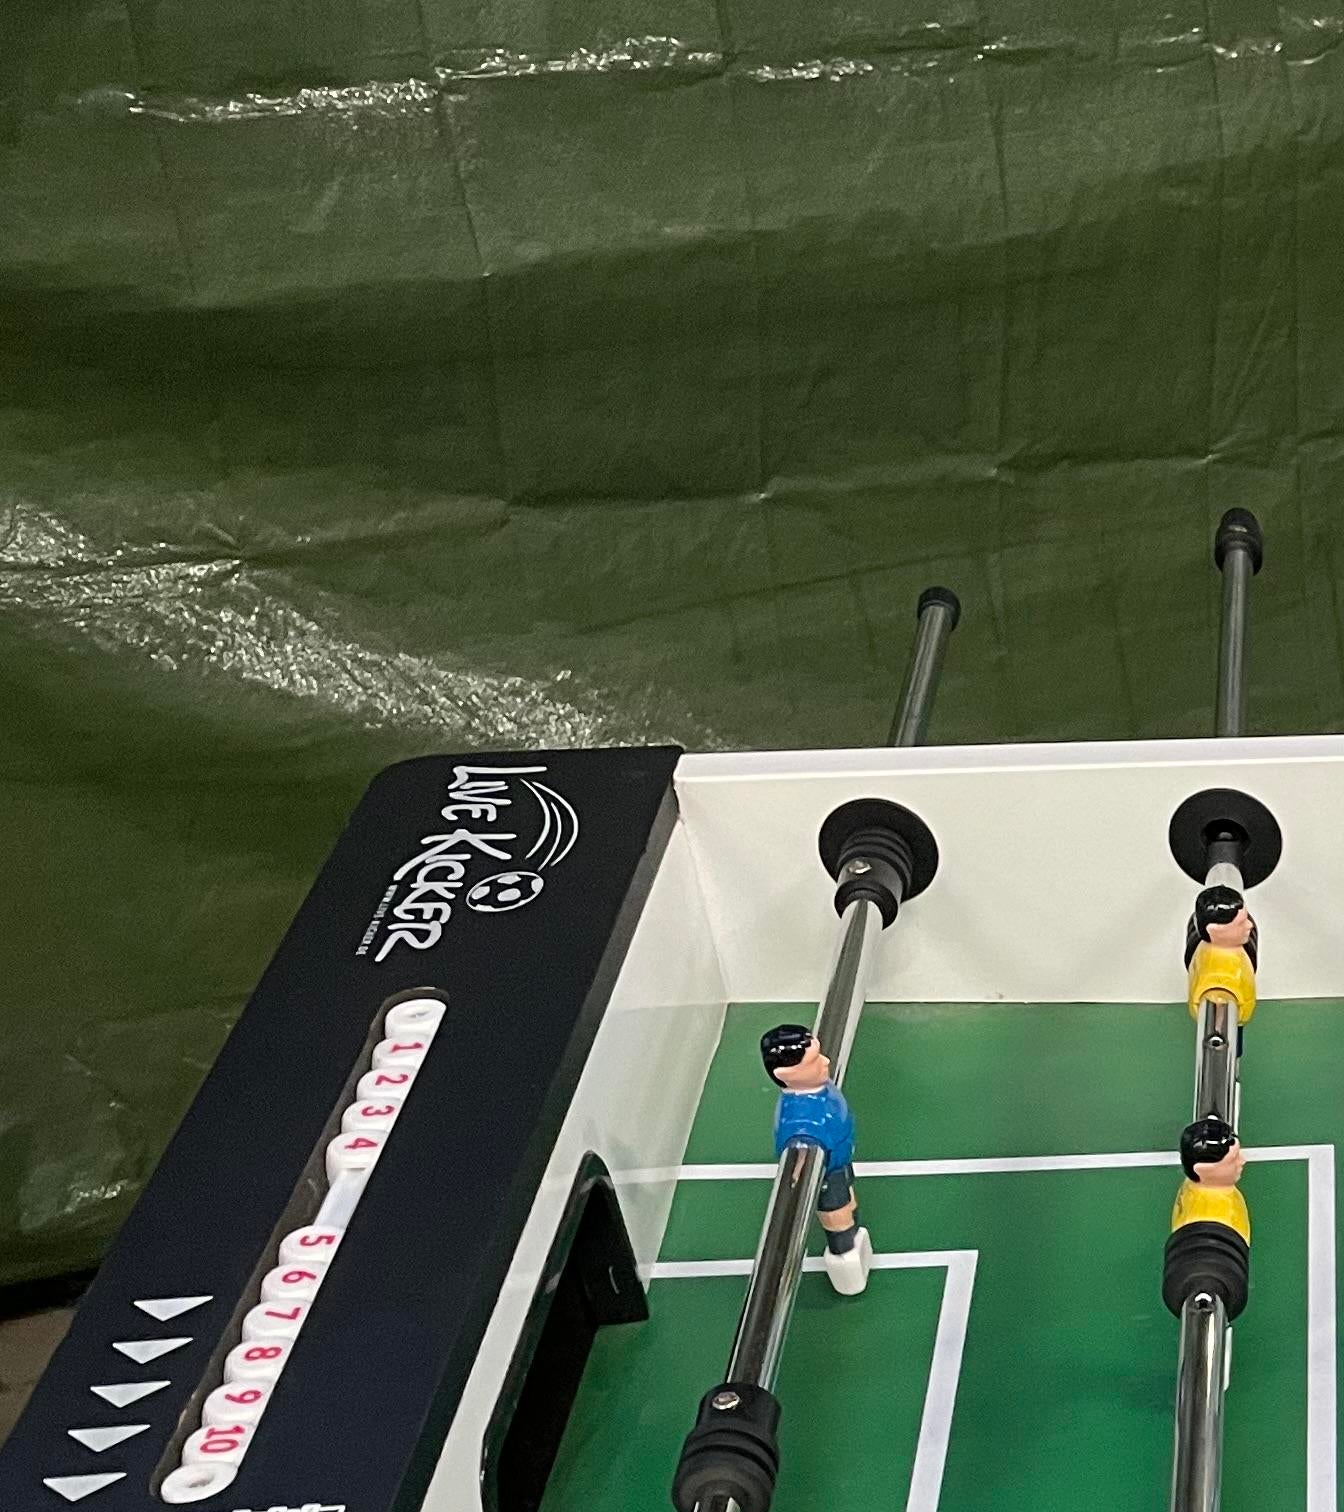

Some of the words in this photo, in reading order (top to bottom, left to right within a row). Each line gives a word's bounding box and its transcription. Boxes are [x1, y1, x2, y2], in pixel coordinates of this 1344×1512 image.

[441, 766, 548, 822] LIVE
[374, 828, 517, 962] KICKER
[390, 1042, 424, 1053] 1
[375, 1073, 409, 1086] 2
[361, 1104, 395, 1117] 3
[344, 1137, 379, 1149] 4
[299, 1234, 336, 1247] 5
[281, 1269, 317, 1284] 6
[264, 1306, 301, 1321] 7
[243, 1346, 282, 1361] 8
[224, 1389, 263, 1404] 9
[200, 1424, 246, 1453] 10
